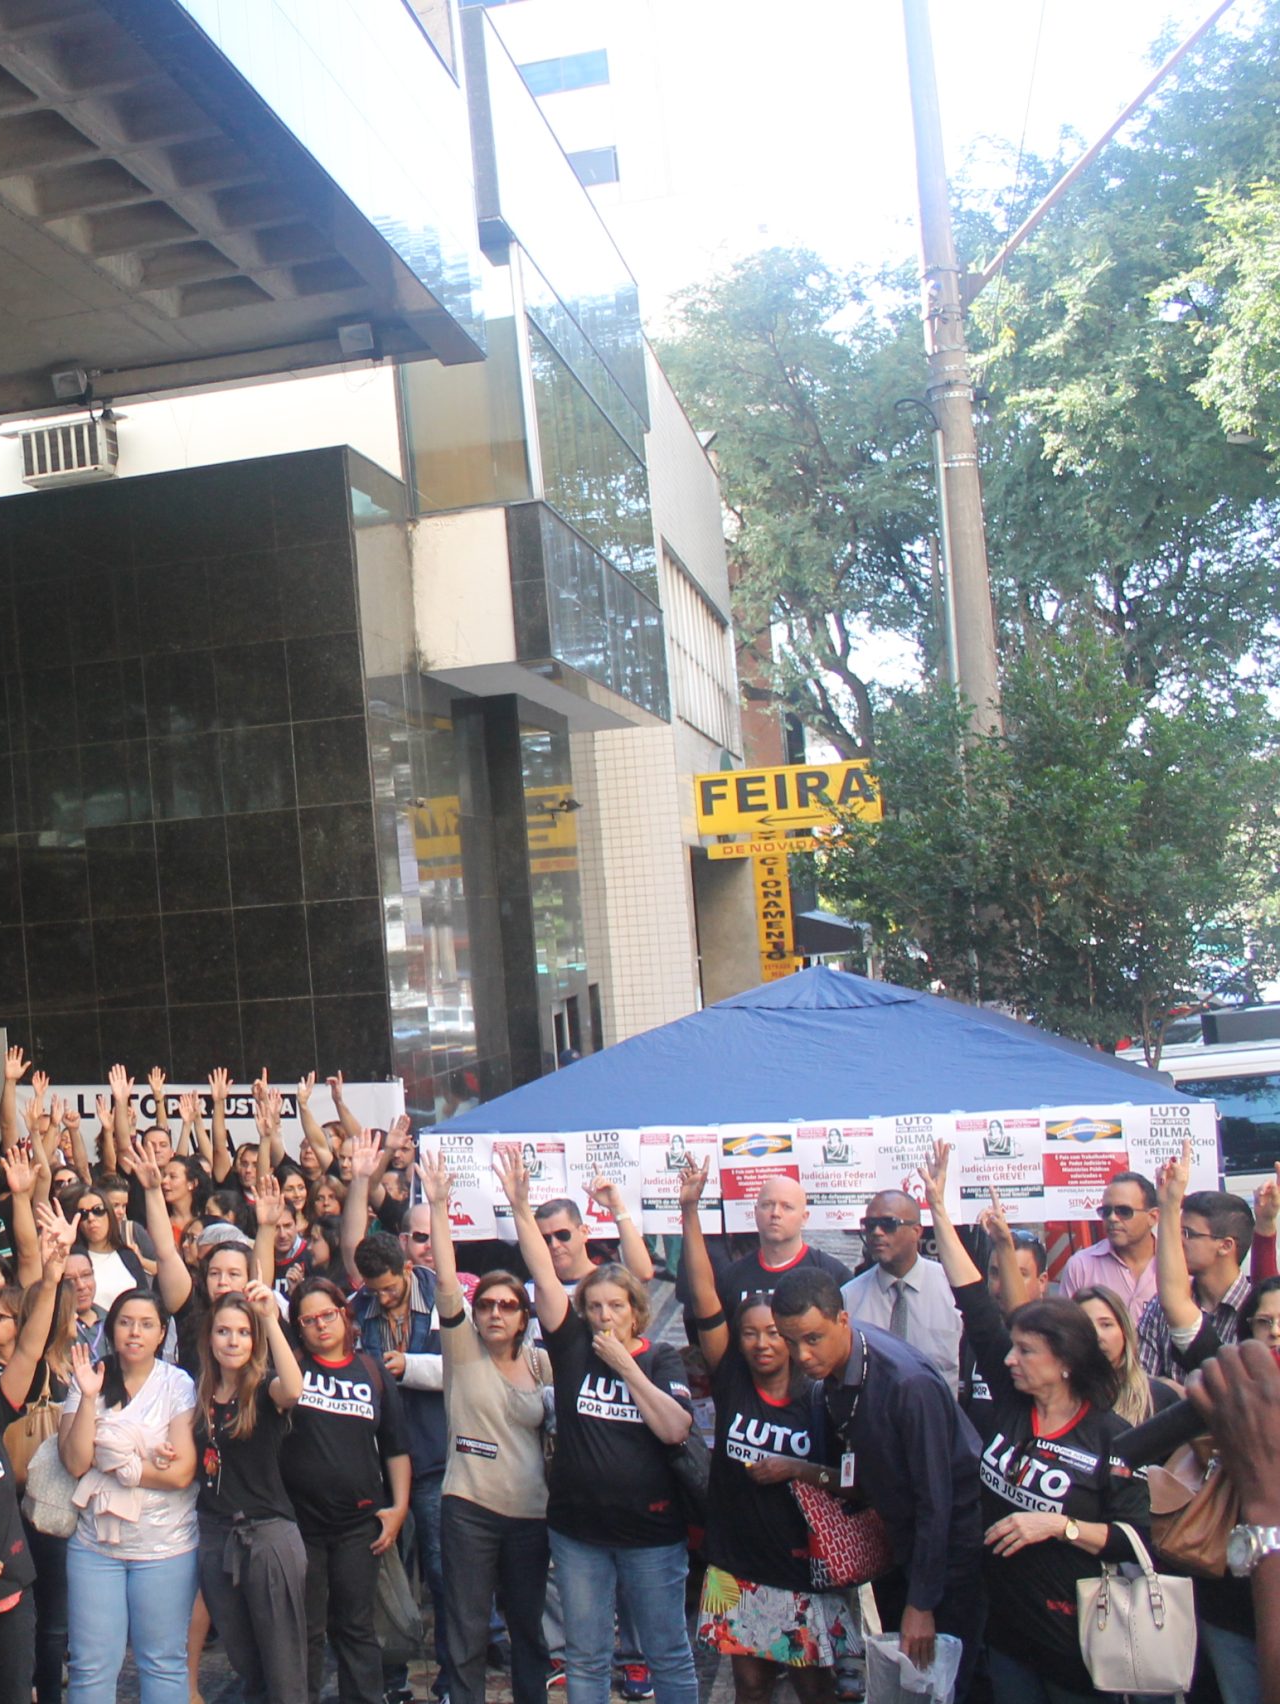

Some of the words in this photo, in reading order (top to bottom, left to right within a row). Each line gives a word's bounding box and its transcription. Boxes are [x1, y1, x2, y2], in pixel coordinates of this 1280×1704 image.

[699, 768, 877, 816] FEIRA
[723, 844, 745, 856] DE
[1150, 1106, 1190, 1117] LUTO
[895, 1116, 932, 1126] LUTO
[440, 1136, 473, 1146] LUTO
[586, 1132, 619, 1143] LUTO
[1131, 1138, 1160, 1147] CHEGA
[961, 1165, 1004, 1173] Judiciário
[1007, 1162, 1040, 1171] Federal
[801, 1171, 841, 1180] Judiciário
[844, 1170, 877, 1179] Federal
[992, 1173, 1025, 1181] GREVE!
[831, 1180, 862, 1188] GREVE!
[303, 1371, 371, 1401] LUTO
[580, 1373, 630, 1403] LUT
[302, 1394, 323, 1406] POR
[327, 1400, 372, 1417] JUSTIÇA
[579, 1400, 602, 1414] POR
[605, 1406, 640, 1419] JUSTI
[728, 1412, 811, 1457] LUTO
[1036, 1439, 1061, 1453] LUTO
[728, 1445, 751, 1460] POR
[982, 1433, 1071, 1498] LUTO
